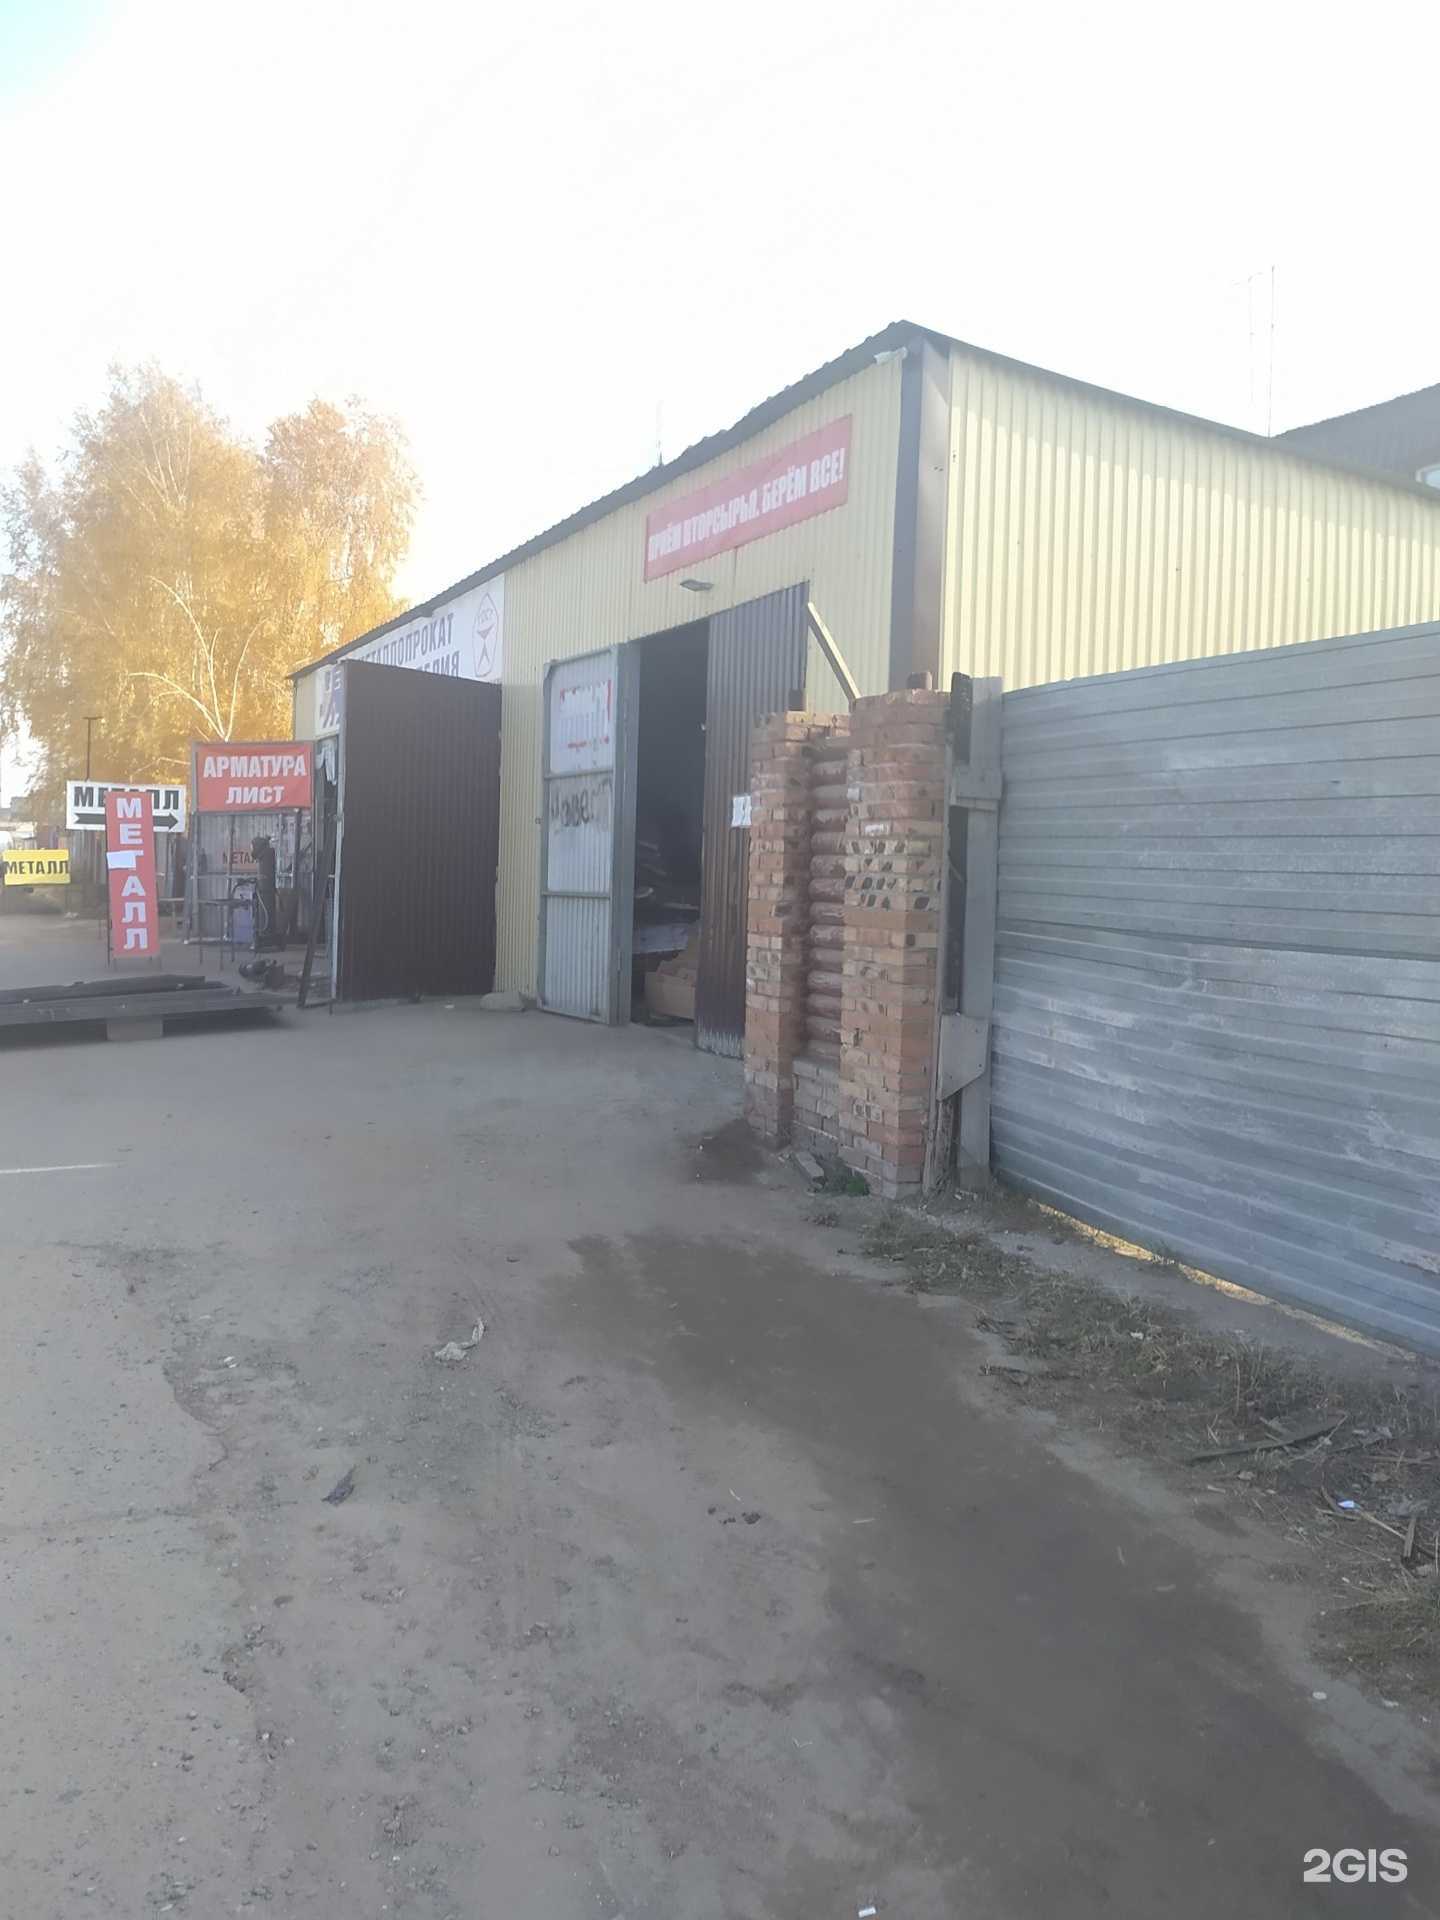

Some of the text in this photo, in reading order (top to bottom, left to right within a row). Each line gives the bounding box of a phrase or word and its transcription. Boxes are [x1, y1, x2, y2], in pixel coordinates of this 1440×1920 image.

[361, 613, 454, 666] АЛЛОПРОКАТ
[203, 754, 307, 778] АРМАТУРА
[74, 786, 180, 810] МЕЛЛ
[225, 785, 285, 804] ЛИСТ
[4, 860, 69, 875] МЕТАЛЛ
